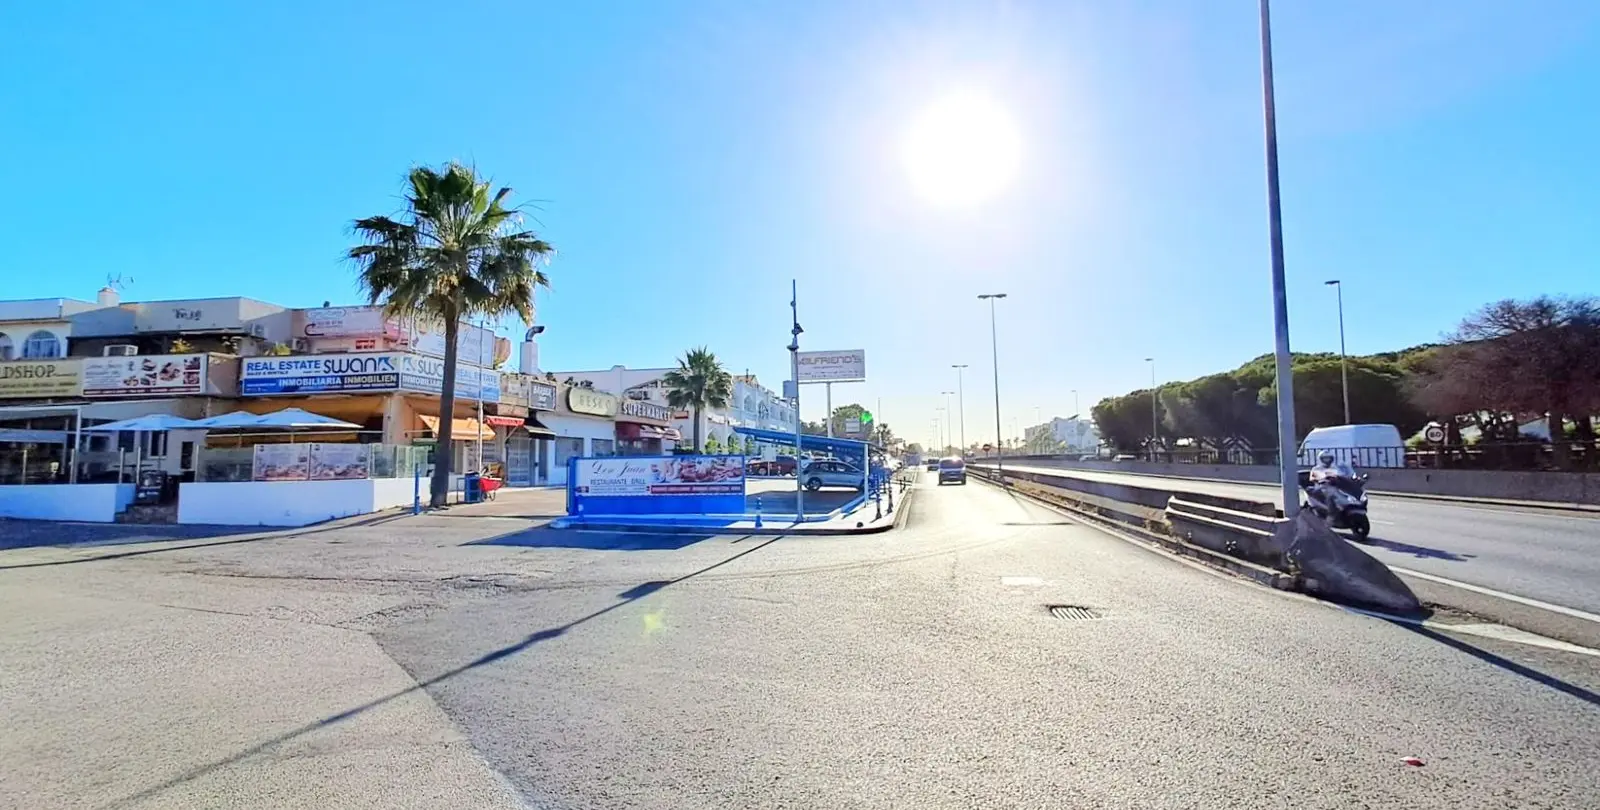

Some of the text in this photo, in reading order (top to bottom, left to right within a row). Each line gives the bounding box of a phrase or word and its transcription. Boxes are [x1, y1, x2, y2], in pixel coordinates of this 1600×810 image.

[247, 360, 321, 371] REAL ESTATE
[278, 377, 342, 387] INMOBILIARIA
[344, 374, 396, 384] INMOBILIEN
[623, 402, 671, 421] SUPERMARKET
